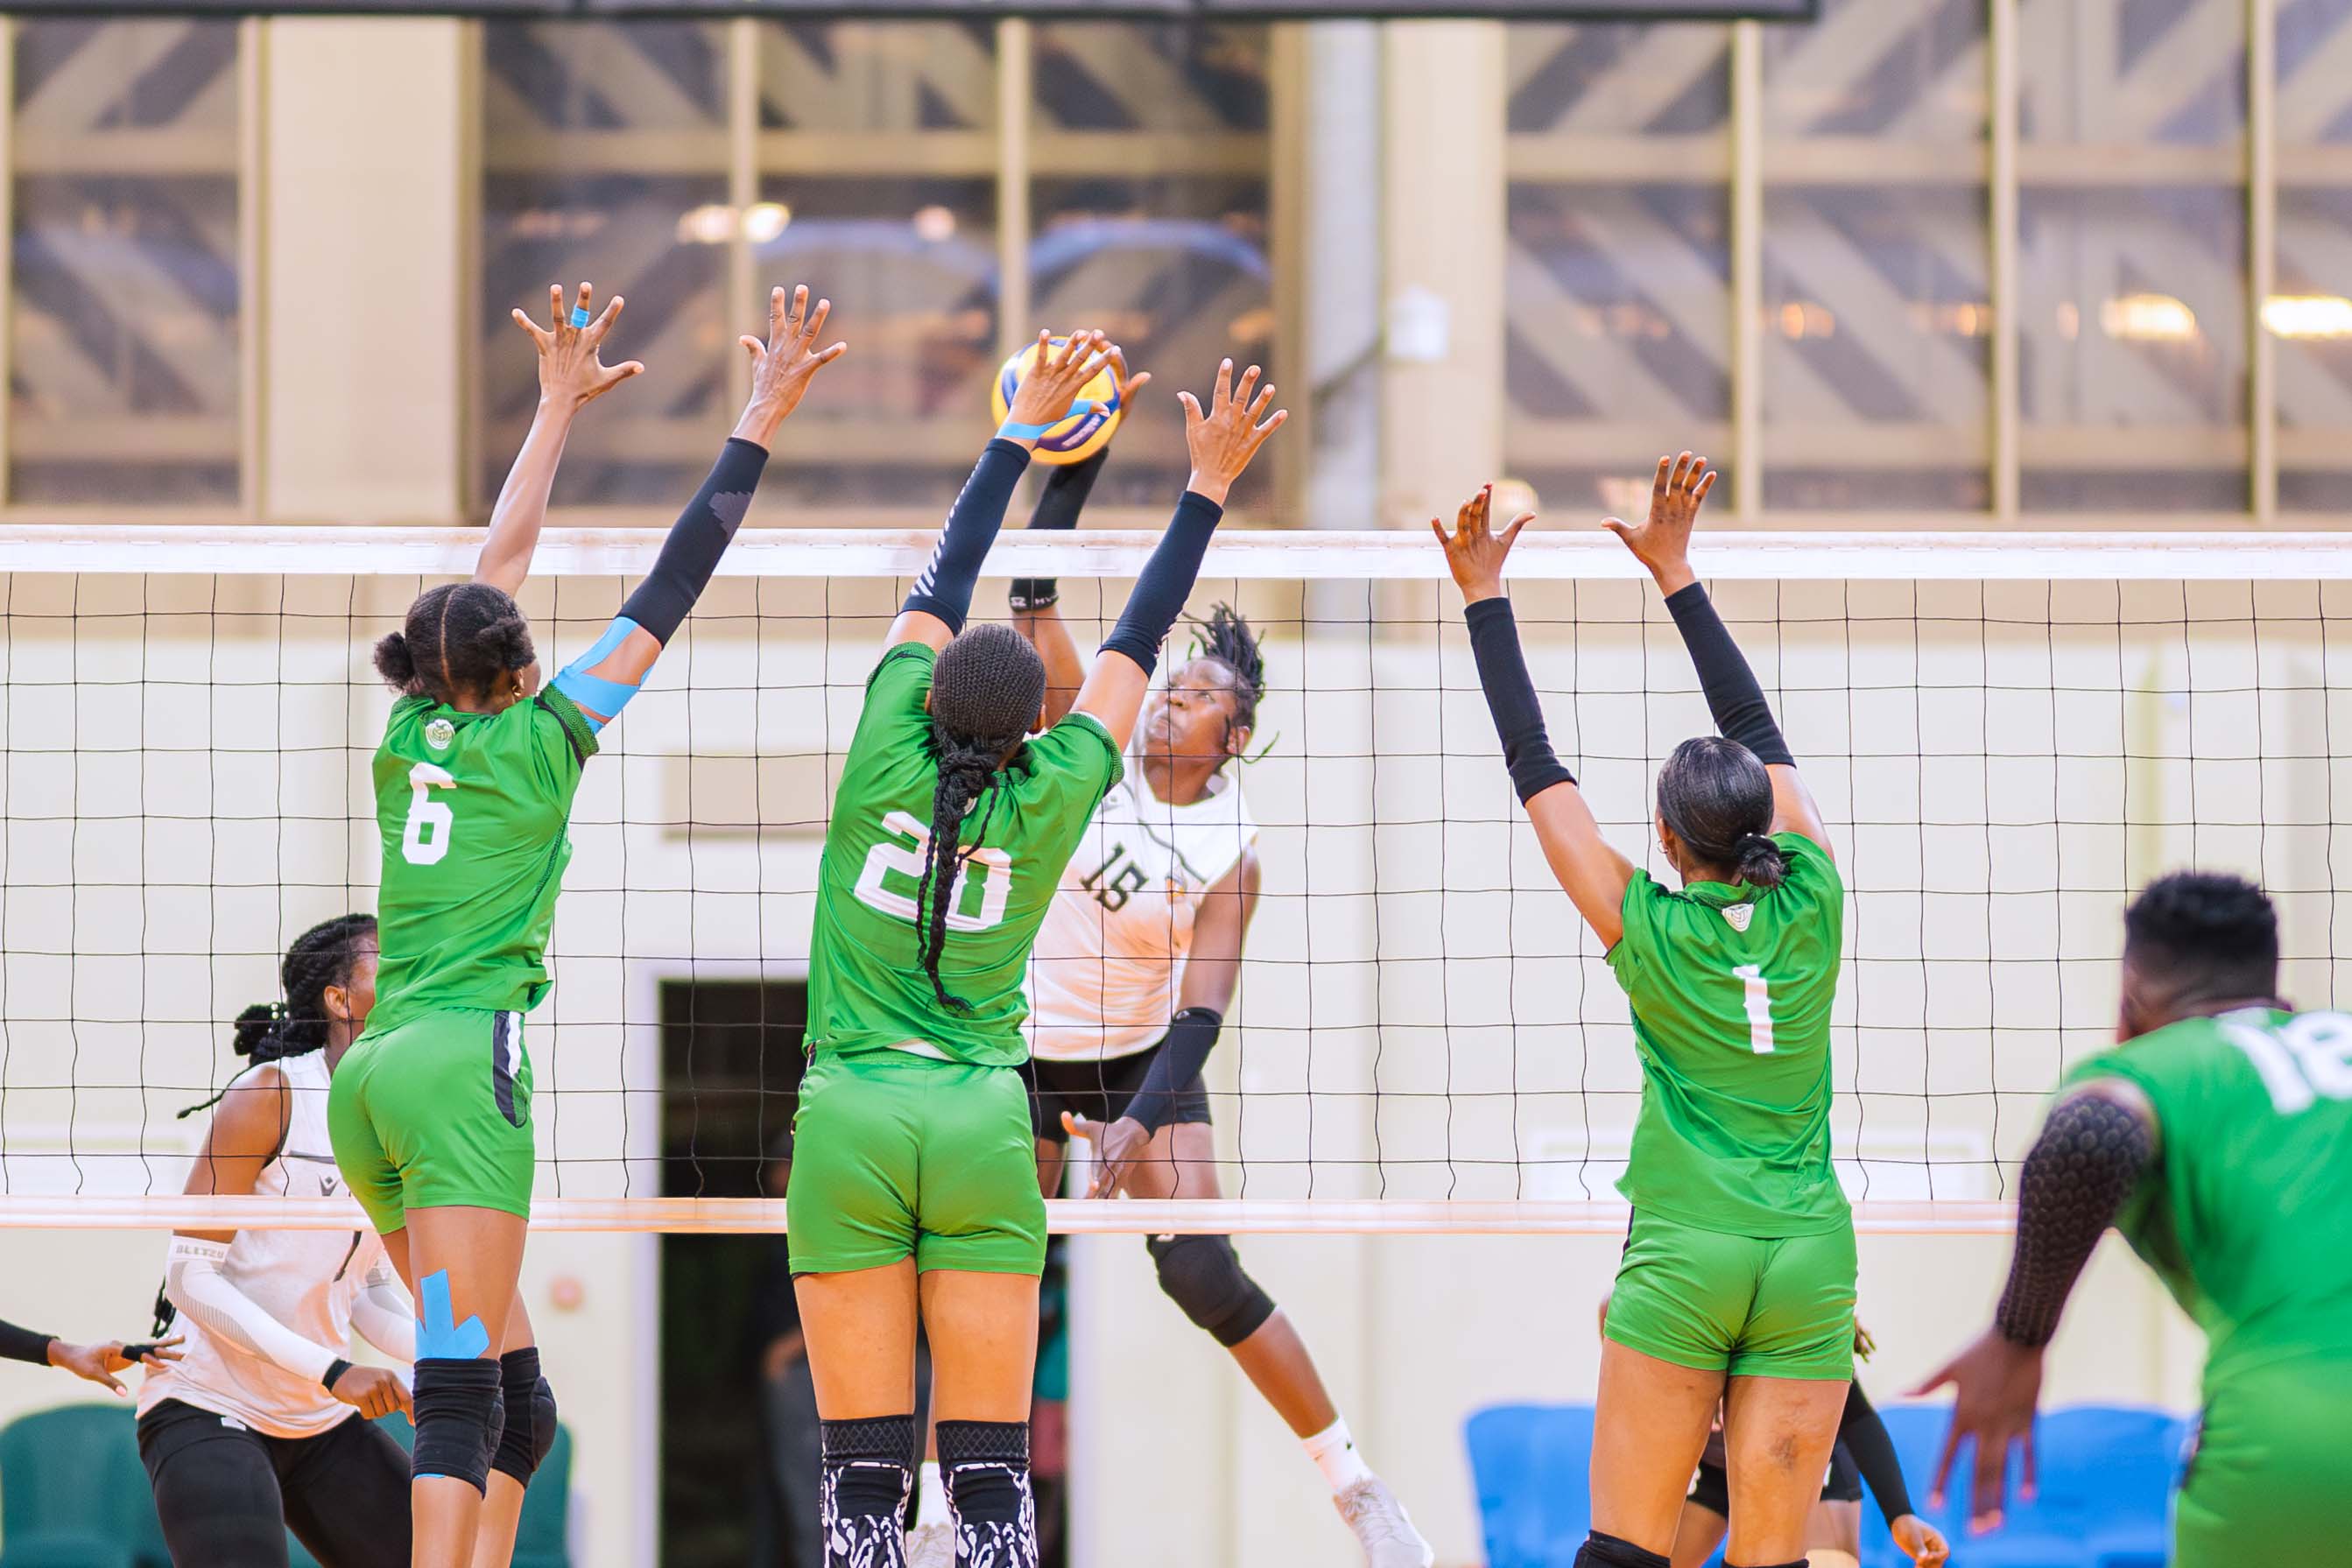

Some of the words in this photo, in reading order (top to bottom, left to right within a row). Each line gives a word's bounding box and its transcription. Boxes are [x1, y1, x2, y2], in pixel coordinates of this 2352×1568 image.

[402, 762, 457, 865] 6
[854, 811, 1012, 931] 20
[1732, 964, 1775, 1054] 1
